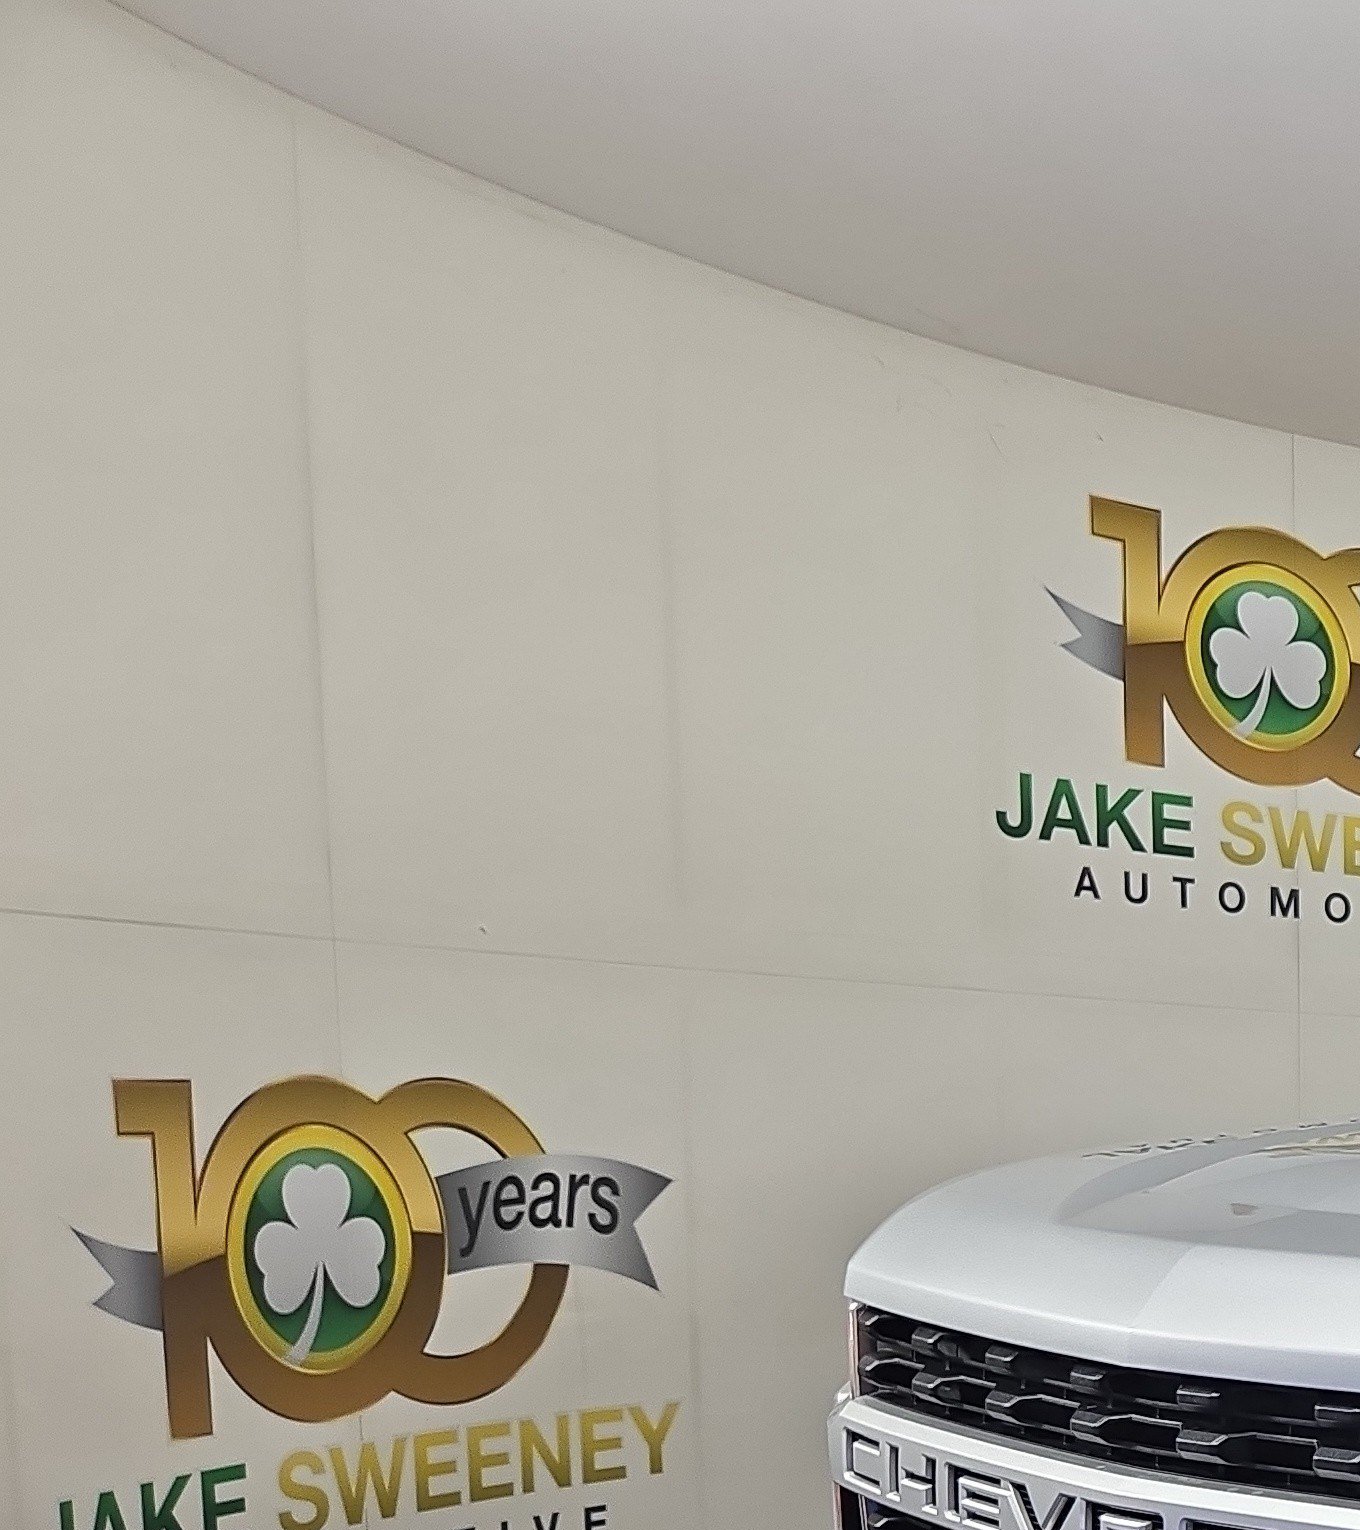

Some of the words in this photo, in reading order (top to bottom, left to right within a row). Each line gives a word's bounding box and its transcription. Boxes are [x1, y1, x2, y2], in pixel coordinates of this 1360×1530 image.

[995, 771, 1195, 858] JAKE
[112, 1074, 569, 1438] 100
[457, 1169, 621, 1258] years
